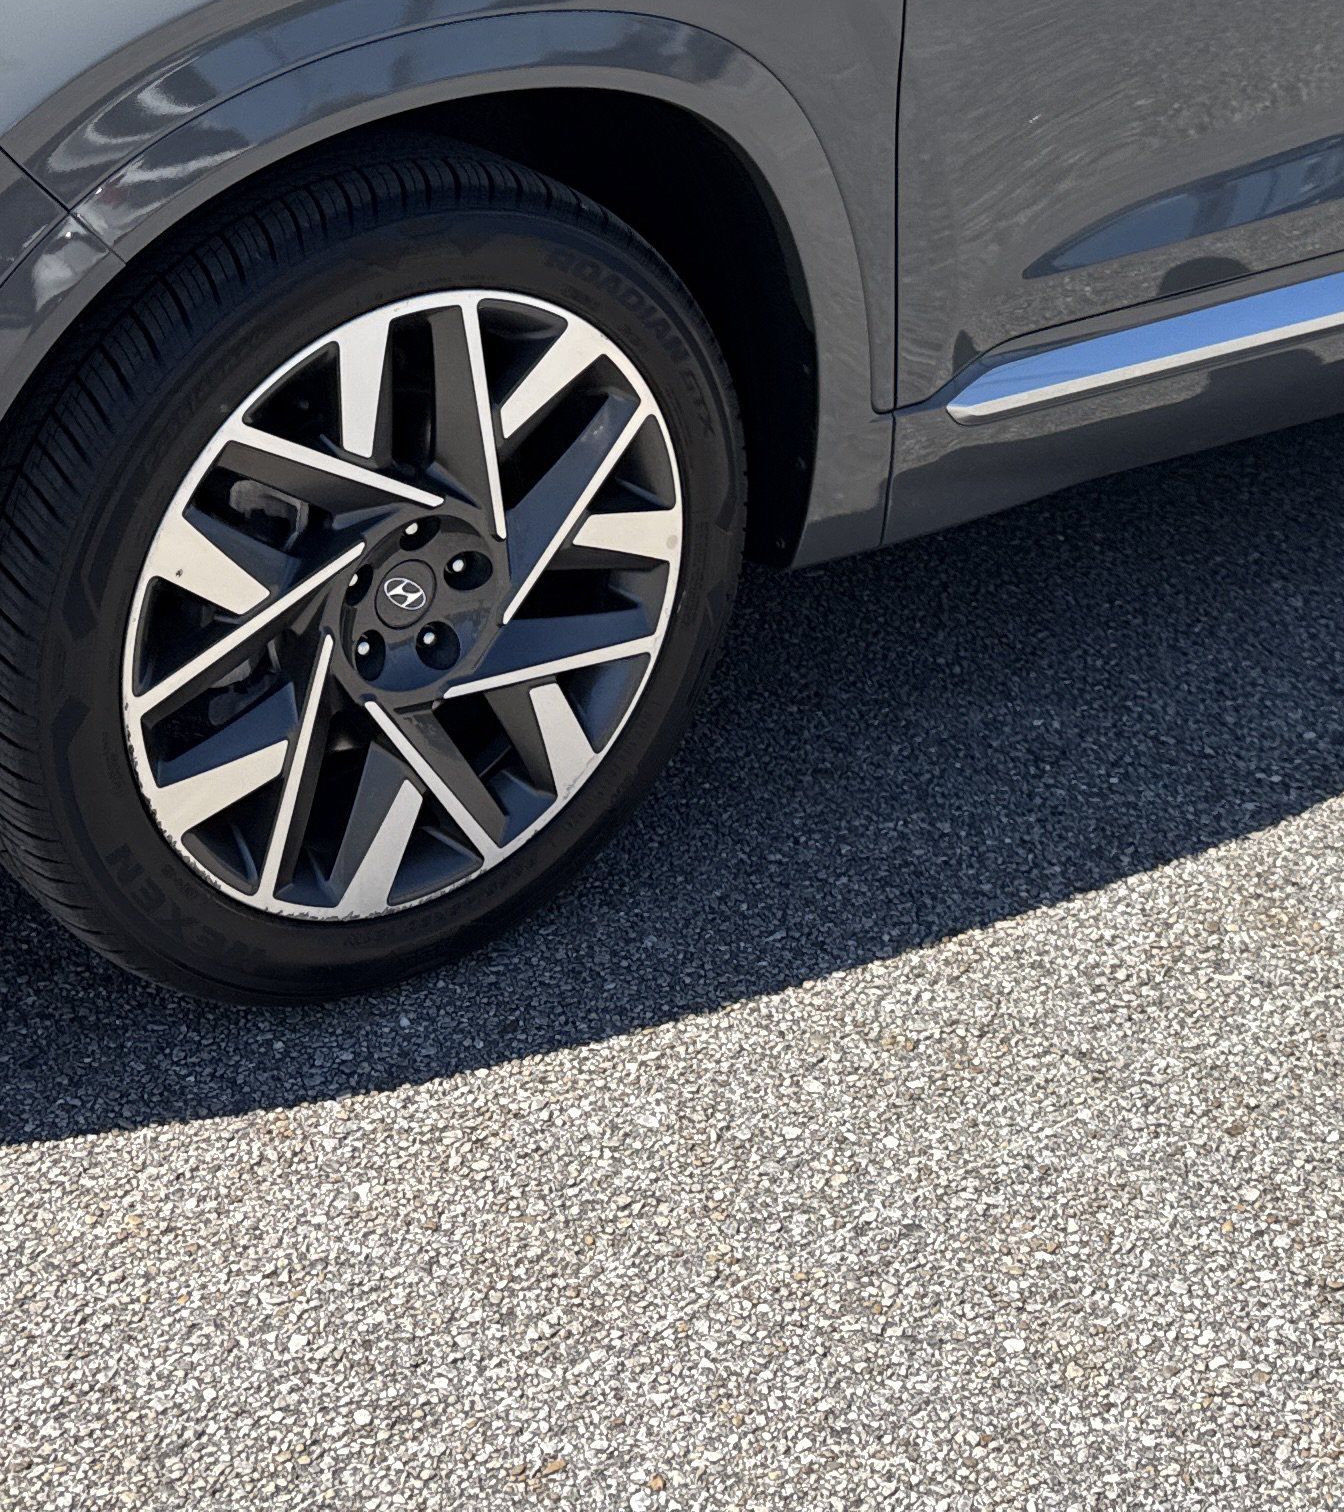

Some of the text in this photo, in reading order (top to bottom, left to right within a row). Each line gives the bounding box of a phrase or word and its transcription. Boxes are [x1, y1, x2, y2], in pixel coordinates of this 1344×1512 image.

[543, 248, 717, 436] ROADIAN GTX
[105, 842, 267, 970] NEXEN
